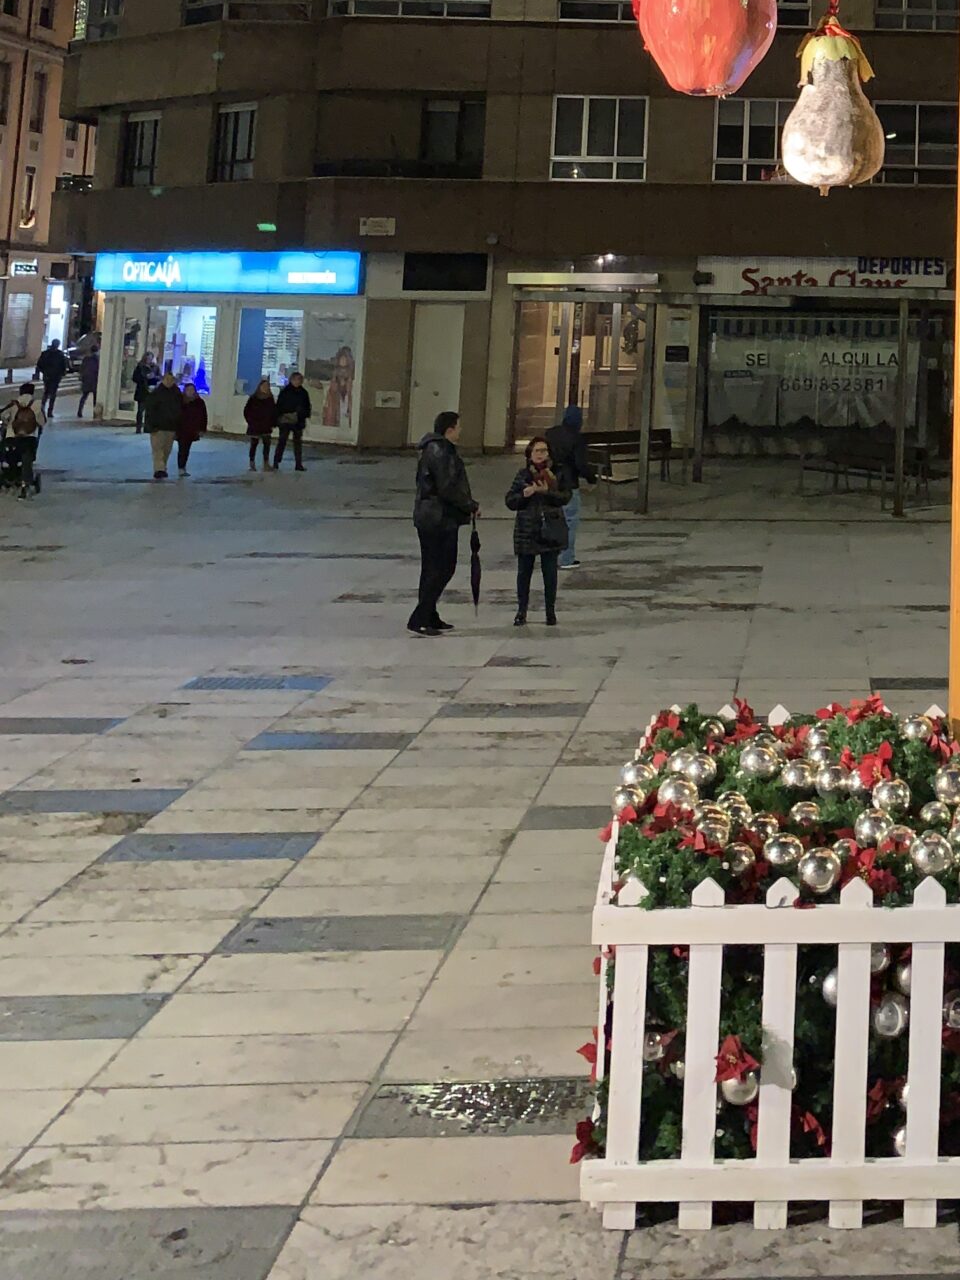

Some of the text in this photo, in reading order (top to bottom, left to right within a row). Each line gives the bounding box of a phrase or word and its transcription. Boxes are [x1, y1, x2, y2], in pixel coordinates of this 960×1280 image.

[857, 256, 945, 276] DEPORTES
[745, 351, 899, 367] SE ALQUILA
